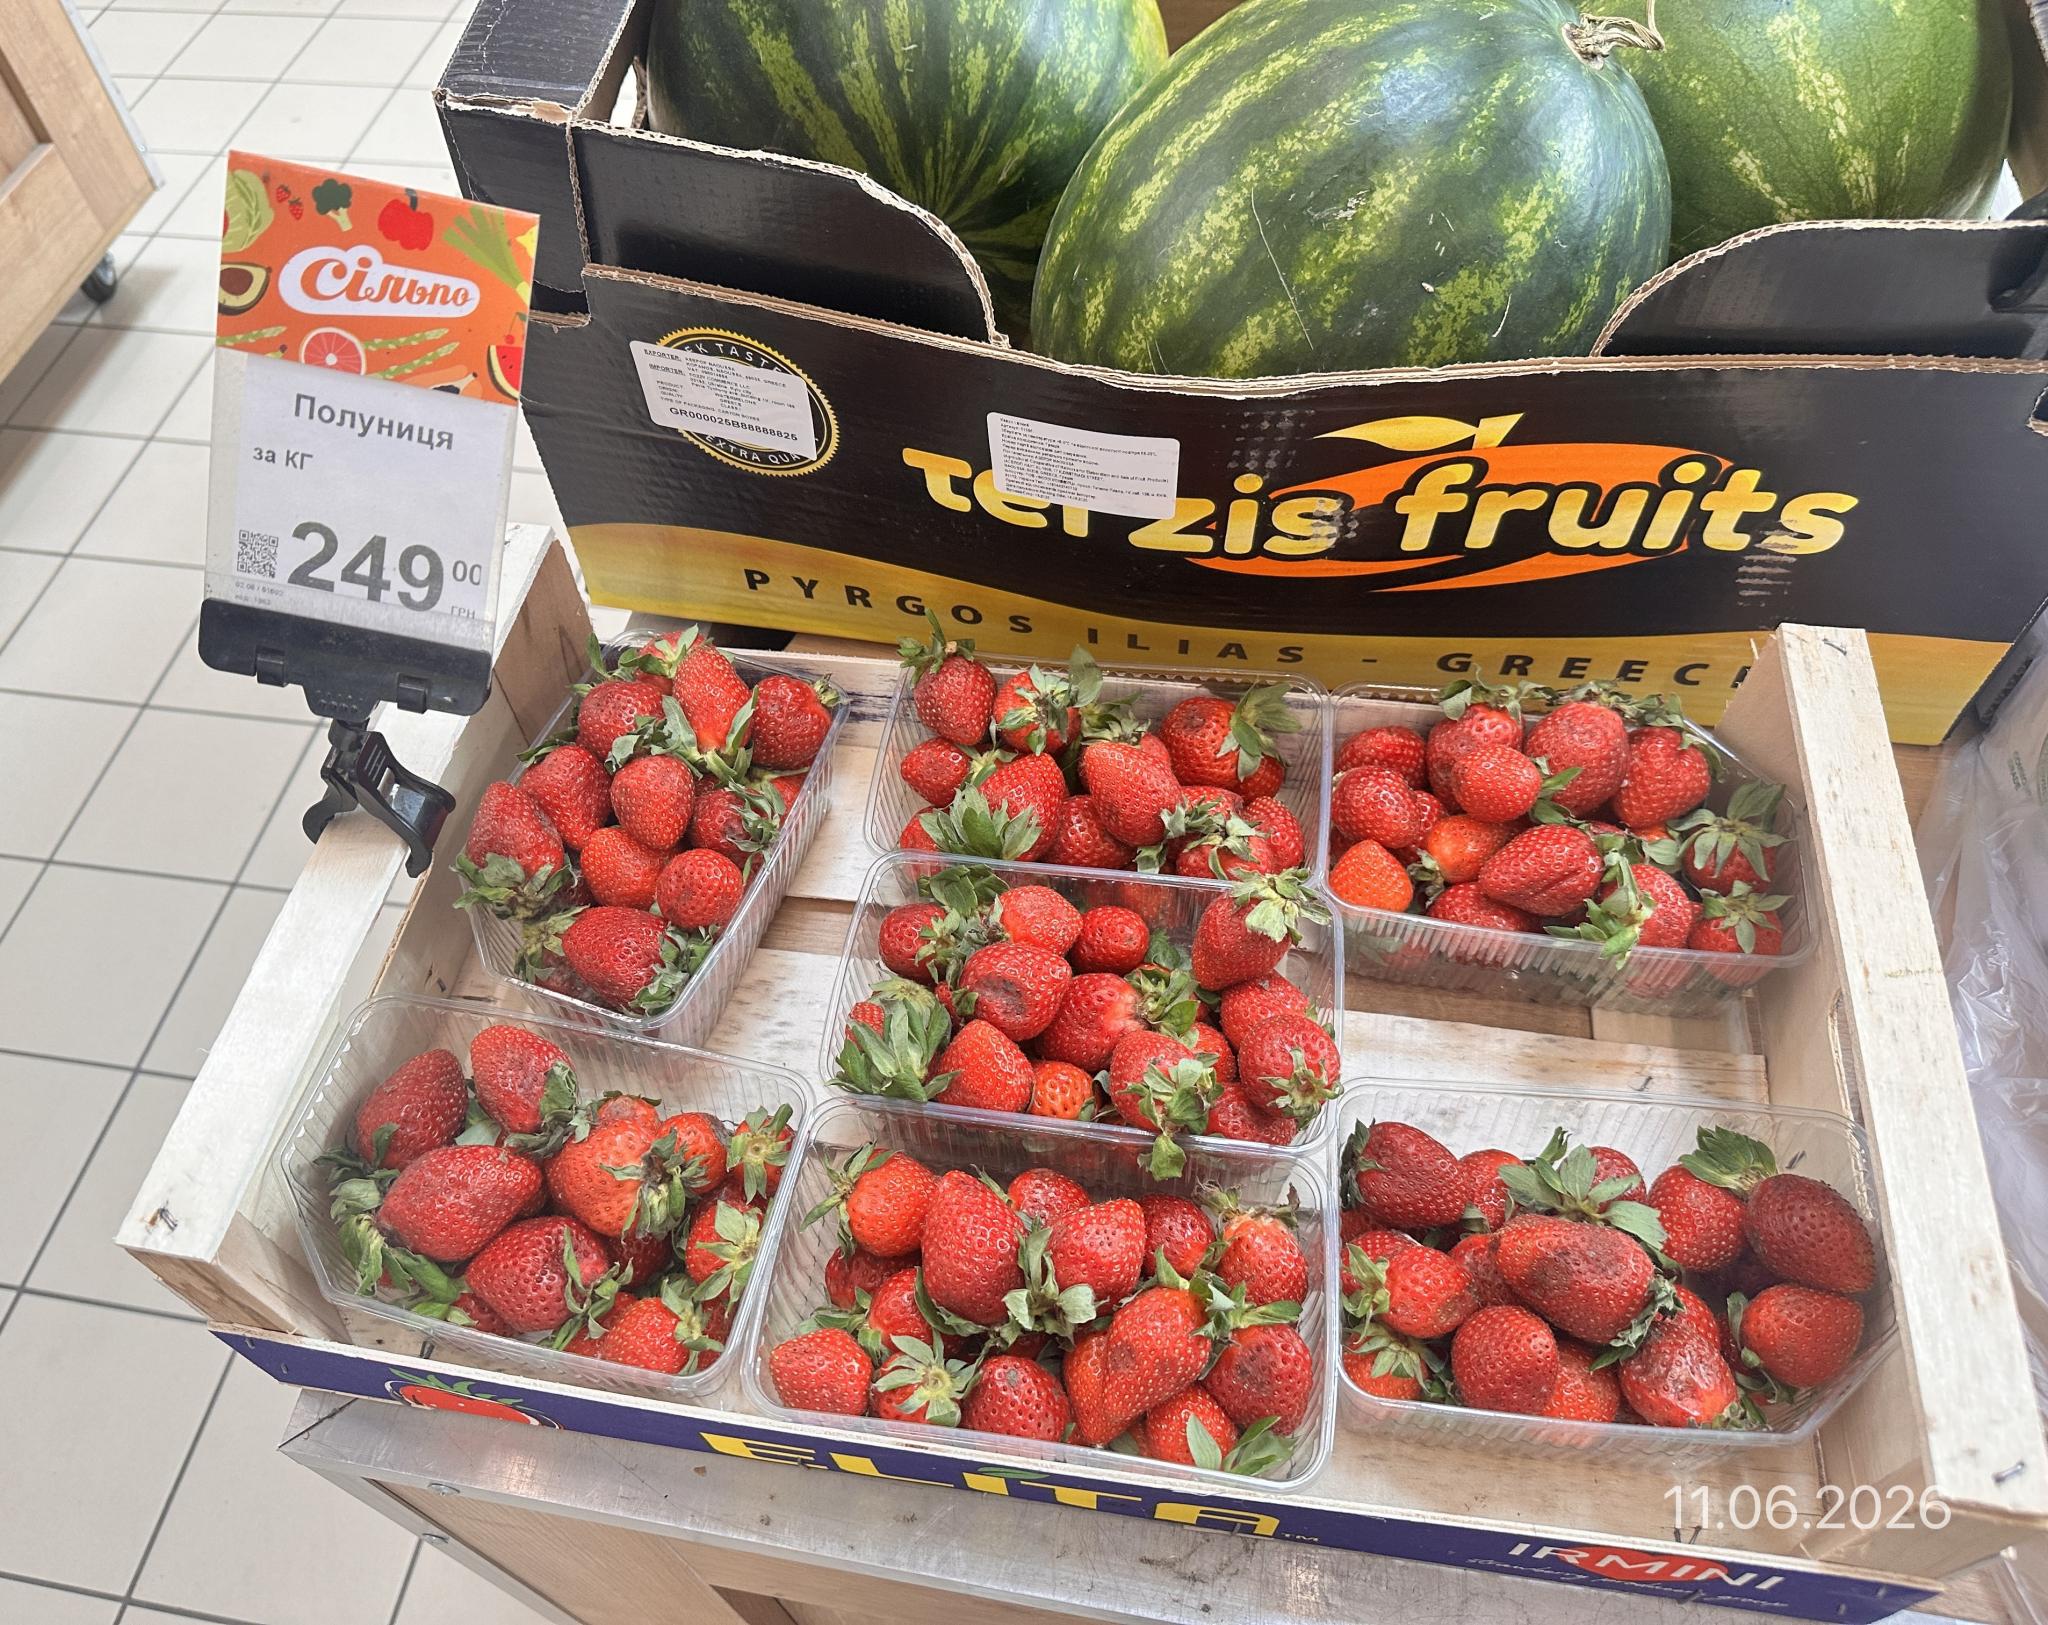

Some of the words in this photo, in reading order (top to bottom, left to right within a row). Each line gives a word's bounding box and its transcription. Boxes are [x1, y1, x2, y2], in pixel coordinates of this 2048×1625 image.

[300, 256, 472, 306] Сільпо
[294, 393, 454, 450] Полуниця
[706, 435, 761, 461] EXTRA
[253, 447, 276, 464] за
[1395, 461, 1859, 555] fruits
[287, 521, 444, 612] 249
[452, 560, 482, 586] 00
[743, 568, 1033, 635] PYRGOS
[1088, 627, 1305, 664] ILIAS
[1508, 1543, 1786, 1590] IRMINI
